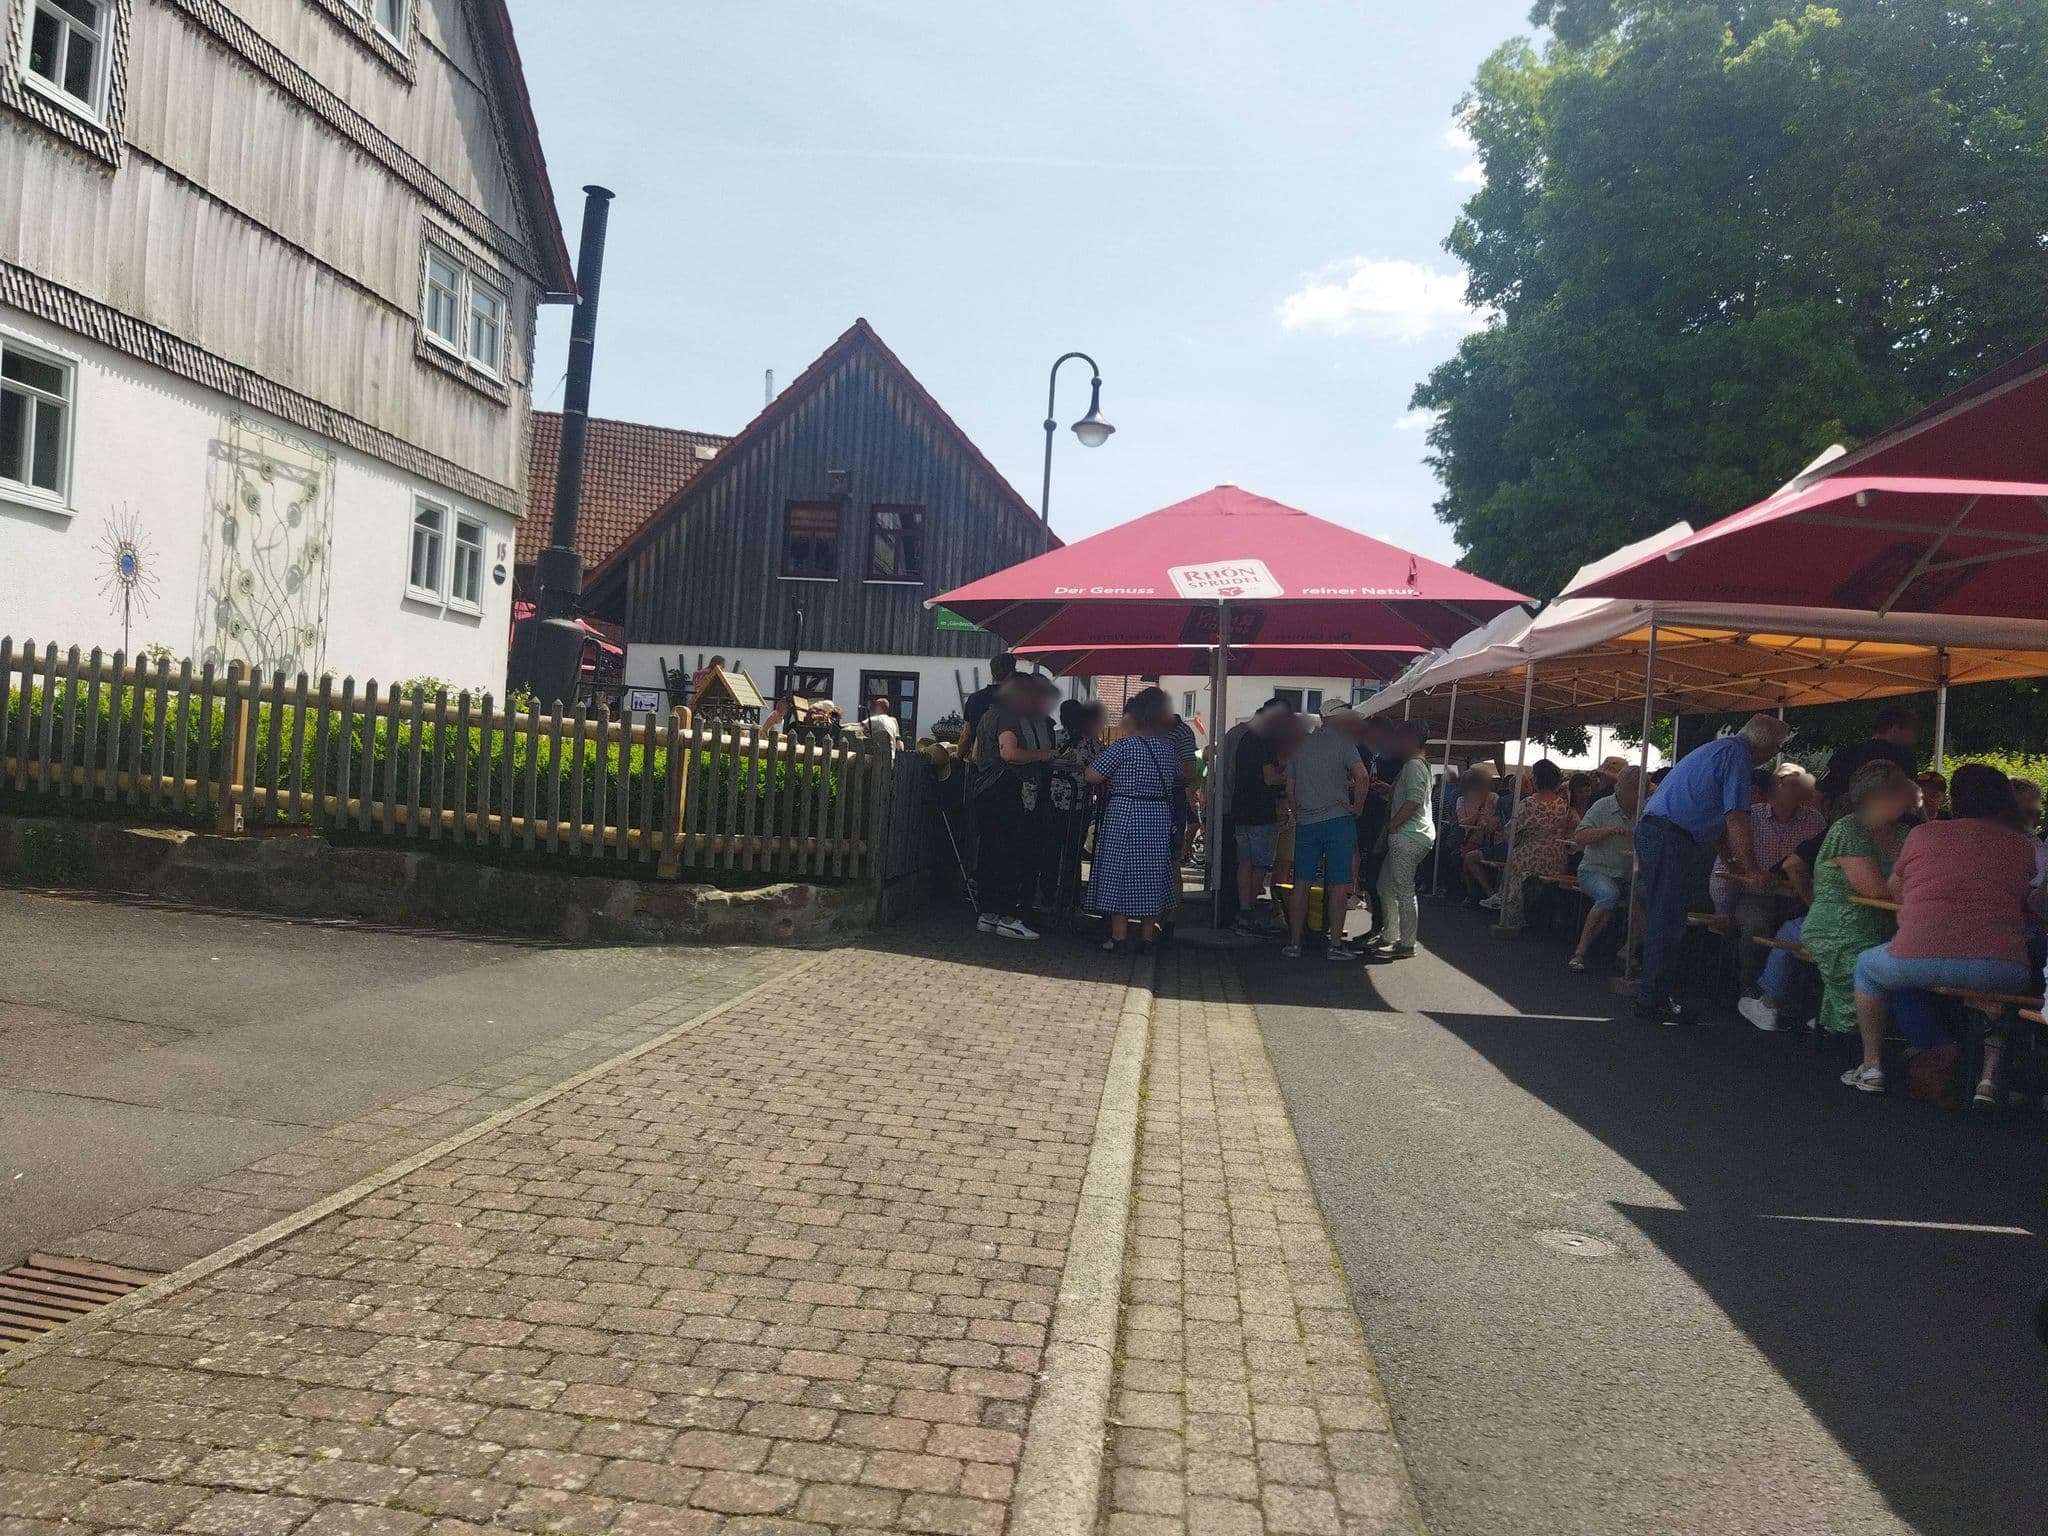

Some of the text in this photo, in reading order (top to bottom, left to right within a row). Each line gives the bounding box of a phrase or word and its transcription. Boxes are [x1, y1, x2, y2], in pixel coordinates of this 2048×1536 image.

[496, 542, 507, 562] 15
[1183, 566, 1257, 582] RHÖN
[1188, 577, 1263, 589] SPRUDEL
[1054, 586, 1155, 595] Der Genuss
[1301, 586, 1358, 595] reiner
